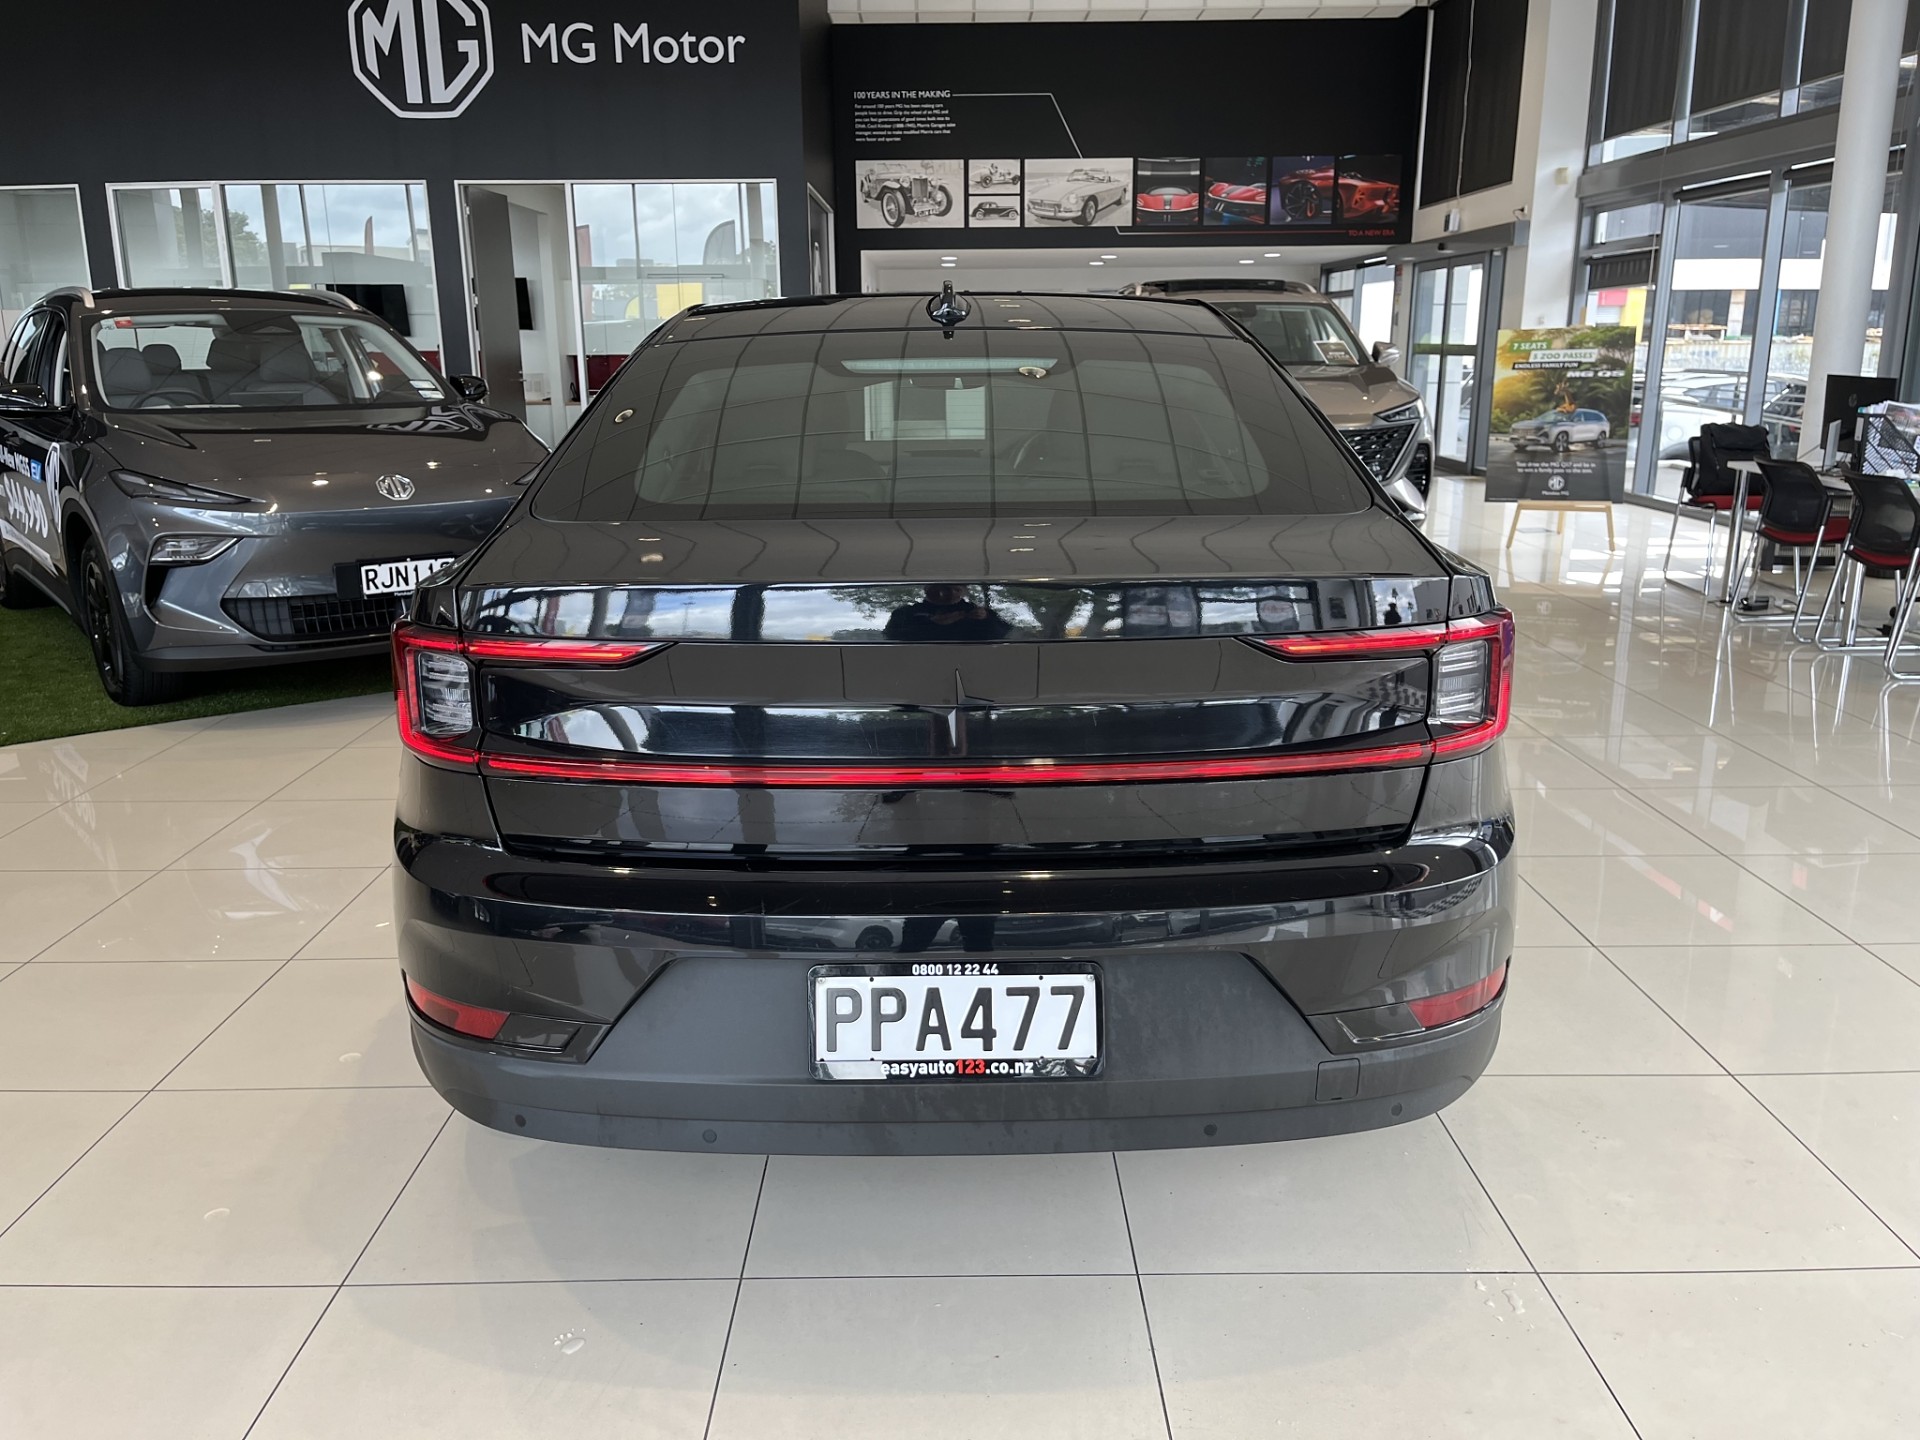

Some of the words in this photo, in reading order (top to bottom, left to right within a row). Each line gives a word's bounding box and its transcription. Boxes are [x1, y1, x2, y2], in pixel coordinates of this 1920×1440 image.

[521, 22, 596, 64] MG
[613, 22, 746, 64] Motor
[362, 0, 480, 104] MG
[854, 91, 866, 99] 100
[866, 91, 890, 99] YEARS
[918, 90, 951, 98] MAKING
[1512, 342, 1519, 350] 7
[1520, 341, 1548, 350] SEATS
[1540, 352, 1561, 360] ZOO
[1566, 370, 1594, 378] MG
[912, 964, 944, 976] 0800
[946, 964, 962, 976] 12
[964, 964, 980, 976] 22
[982, 963, 999, 975] 44
[826, 986, 1085, 1052] PPA477
[881, 1059, 1034, 1077] easyauto123.co.nz
